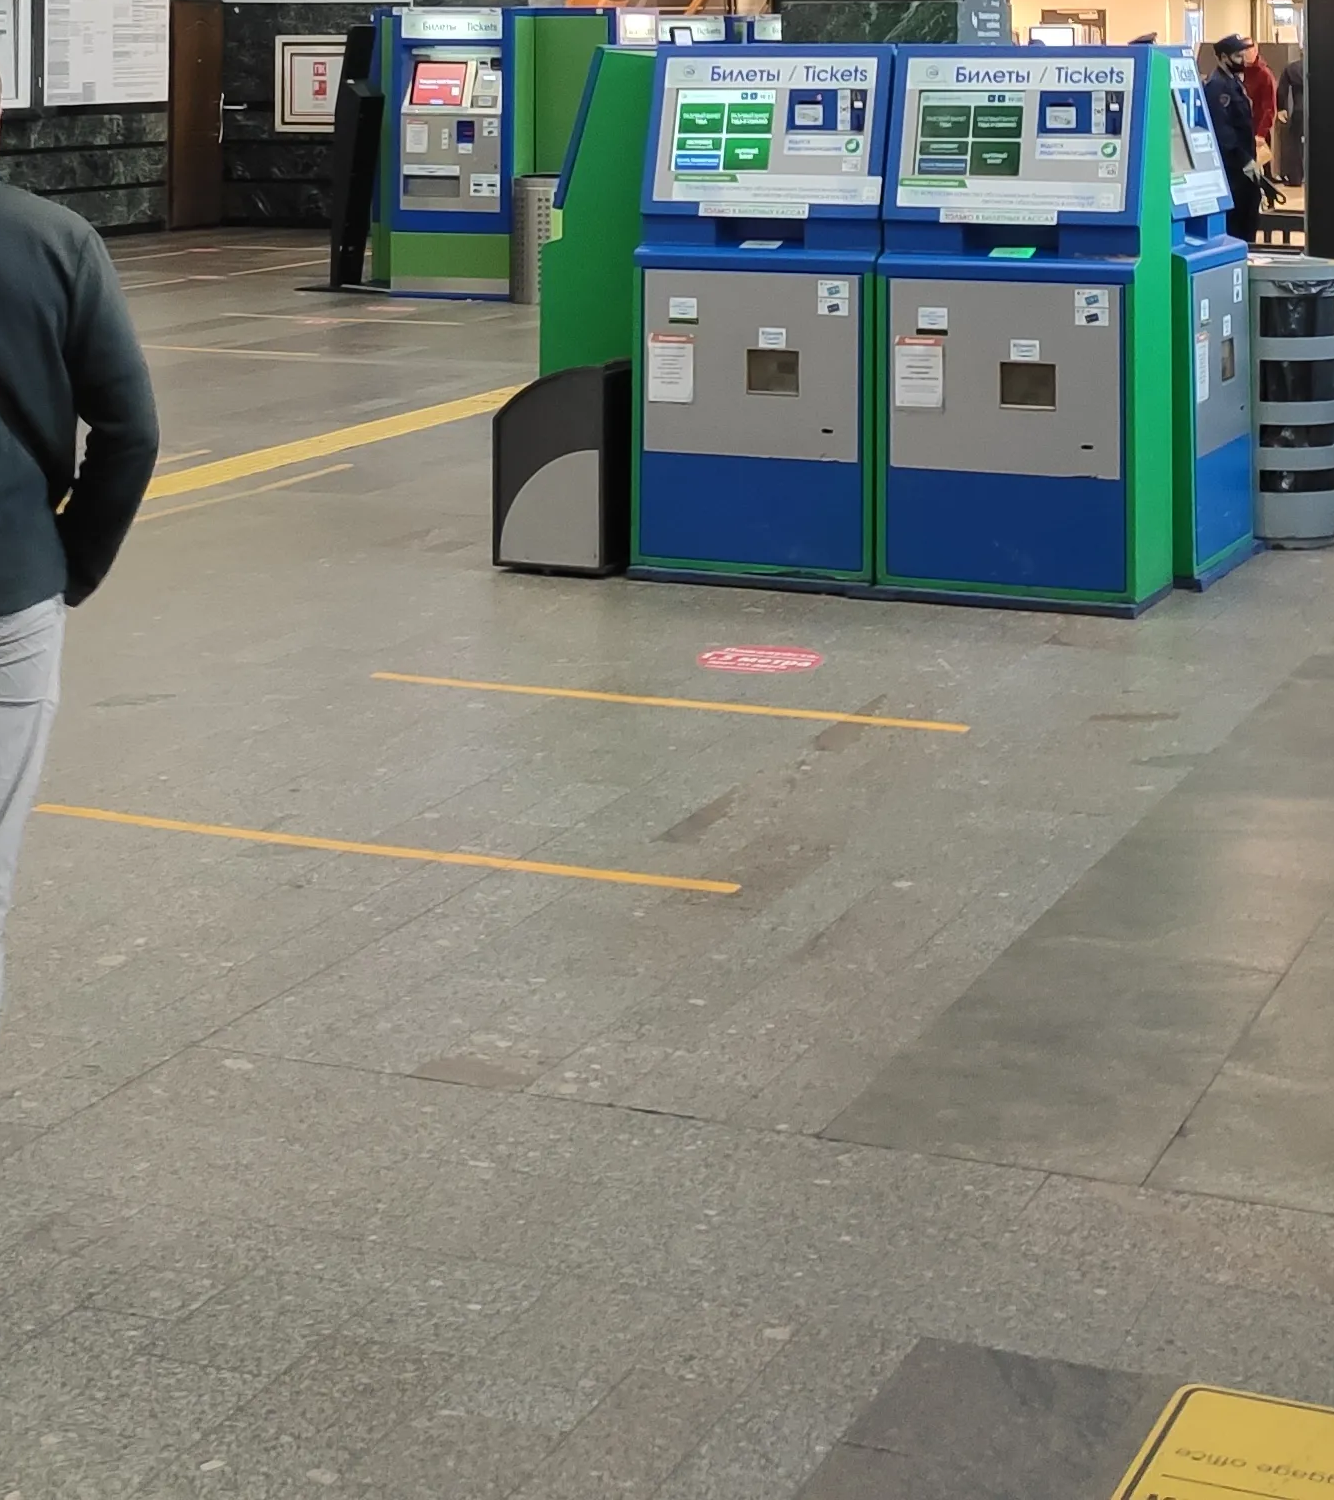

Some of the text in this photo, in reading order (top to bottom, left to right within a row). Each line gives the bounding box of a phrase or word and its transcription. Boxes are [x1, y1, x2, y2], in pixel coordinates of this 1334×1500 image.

[710, 65, 781, 83] Билеты
[802, 65, 869, 83] Tickets
[954, 66, 1031, 84] Билеты
[1054, 66, 1126, 84] Tickets
[1175, 1446, 1247, 1469] office
